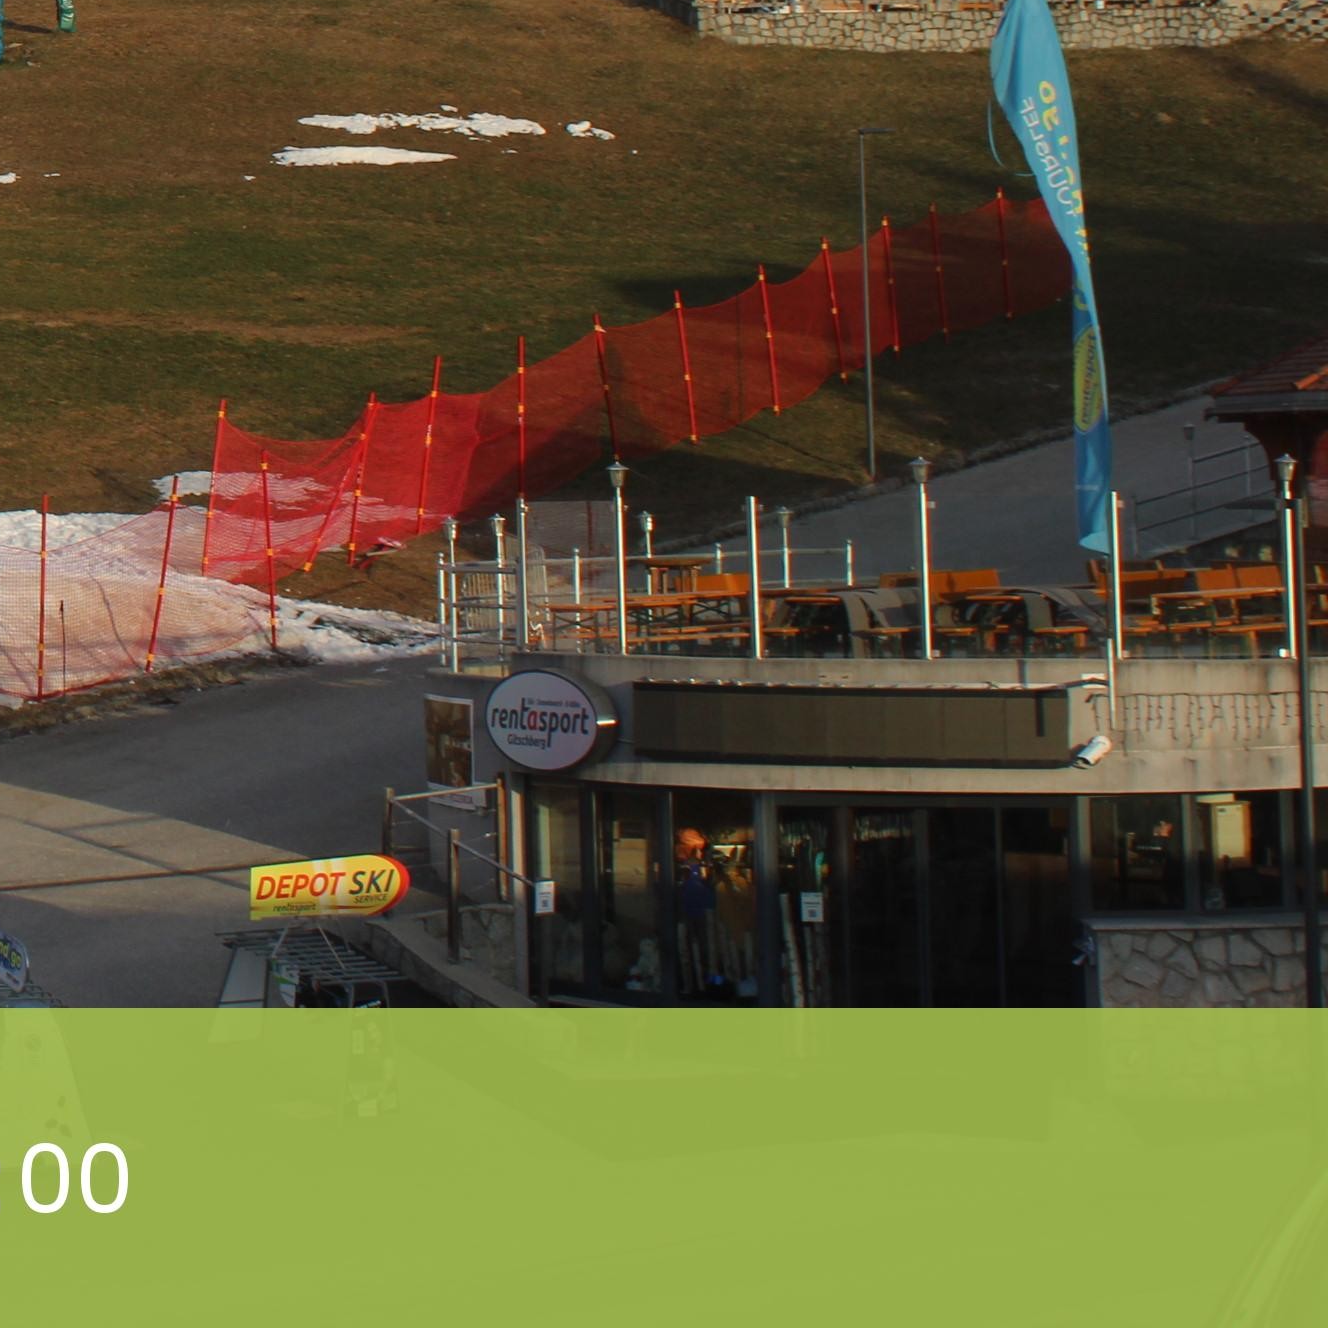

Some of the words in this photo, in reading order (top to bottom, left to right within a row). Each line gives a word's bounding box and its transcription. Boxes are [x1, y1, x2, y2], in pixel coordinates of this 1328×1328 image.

[491, 697, 590, 748] rentasport
[256, 872, 346, 900] DEPOT
[349, 869, 395, 895] SKI
[354, 894, 388, 904] SERVICE
[11, 952, 22, 969] go
